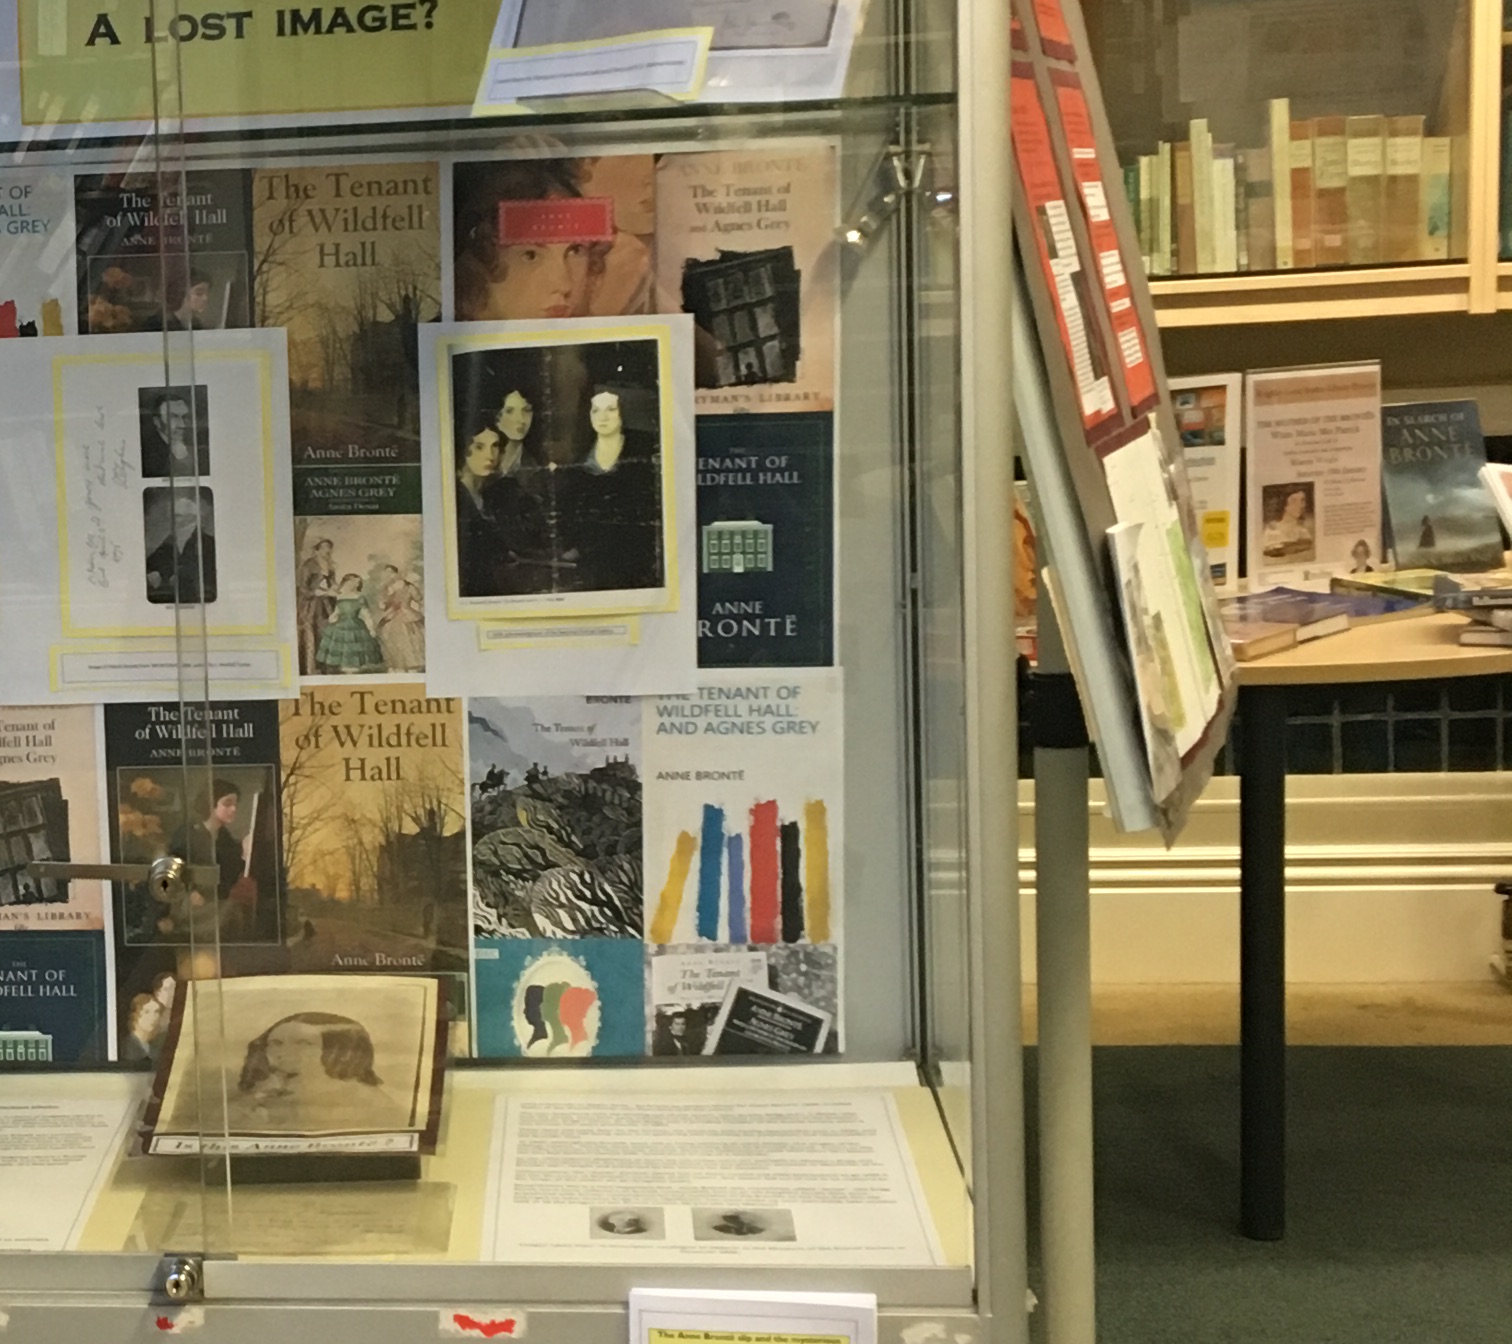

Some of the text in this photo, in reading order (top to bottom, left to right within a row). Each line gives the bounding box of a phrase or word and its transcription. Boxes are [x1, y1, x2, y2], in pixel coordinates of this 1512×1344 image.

[85, 12, 121, 47] A
[145, 9, 254, 45] LOST
[9, 185, 33, 200] OF
[260, 172, 433, 201] The Tenant
[688, 181, 792, 199] The Tenant of
[119, 193, 152, 208] The
[694, 198, 787, 215] Wildfell Hall
[106, 212, 123, 228] of
[194, 208, 227, 225] Hall
[268, 204, 425, 235] of Wildfell
[711, 216, 790, 234] Agnes Grey
[6, 219, 51, 235] GREY
[317, 240, 379, 268] Hall
[1401, 425, 1459, 444] ANNE
[303, 445, 344, 459] Anne
[698, 455, 790, 470] ENANT OF
[305, 476, 341, 487] ANNE
[758, 471, 803, 484] HALL
[310, 487, 396, 498] AGNES GREY
[712, 601, 764, 614] ANNE
[697, 685, 802, 701] TENANT OF
[292, 691, 456, 717] The Tenant
[656, 704, 743, 718] WILDFELL
[148, 706, 240, 722] The Tenant
[43, 718, 56, 731] of
[135, 723, 152, 740] of
[222, 722, 253, 738] Hall
[531, 723, 551, 733] The
[656, 720, 820, 735] AND AGNES GREY
[25, 734, 53, 747] Hall
[295, 722, 450, 750] of Wildfell
[25, 751, 56, 766] Grey
[150, 748, 182, 758] ANNE
[342, 756, 403, 782] Hall
[656, 770, 691, 781] ANNE
[36, 911, 92, 921] LIBRARY
[331, 953, 369, 967] Anne
[45, 969, 67, 982] OF
[39, 984, 78, 997] HALL
[658, 1330, 675, 1339] The
[678, 1332, 701, 1340] Anne
[755, 1335, 771, 1343] and
[774, 1335, 788, 1343] the
